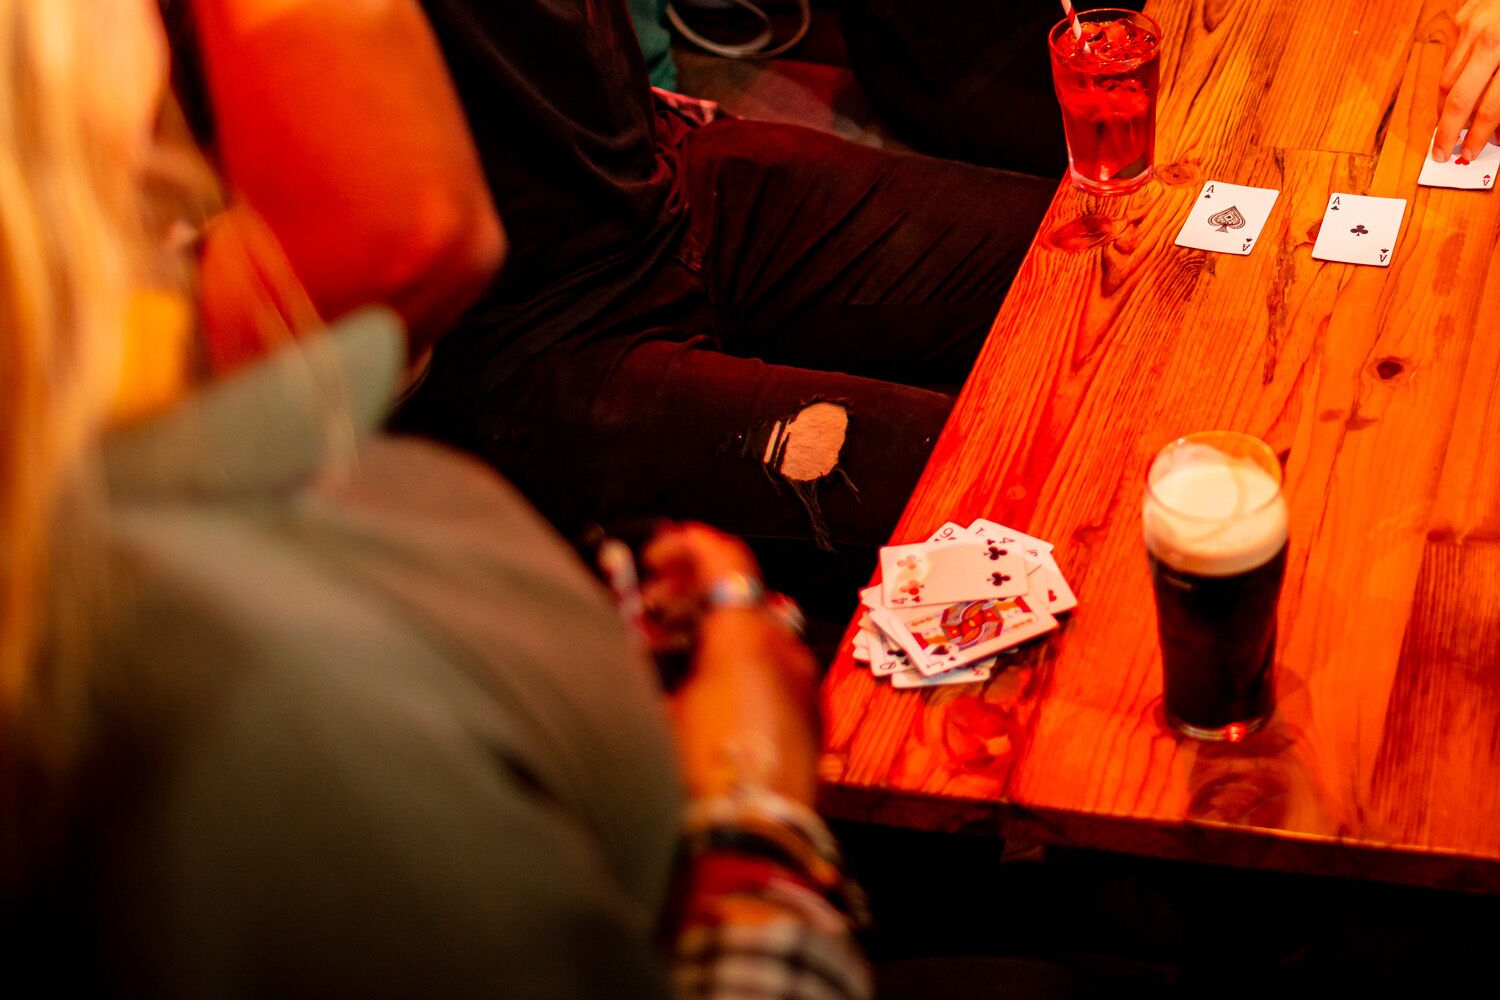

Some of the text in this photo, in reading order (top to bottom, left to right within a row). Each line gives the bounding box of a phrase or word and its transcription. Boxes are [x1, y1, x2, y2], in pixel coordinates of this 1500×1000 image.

[1206, 184, 1215, 194] A
[1332, 196, 1341, 205] A
[1242, 243, 1251, 252] A
[1379, 253, 1388, 263] A
[940, 527, 954, 539] 9
